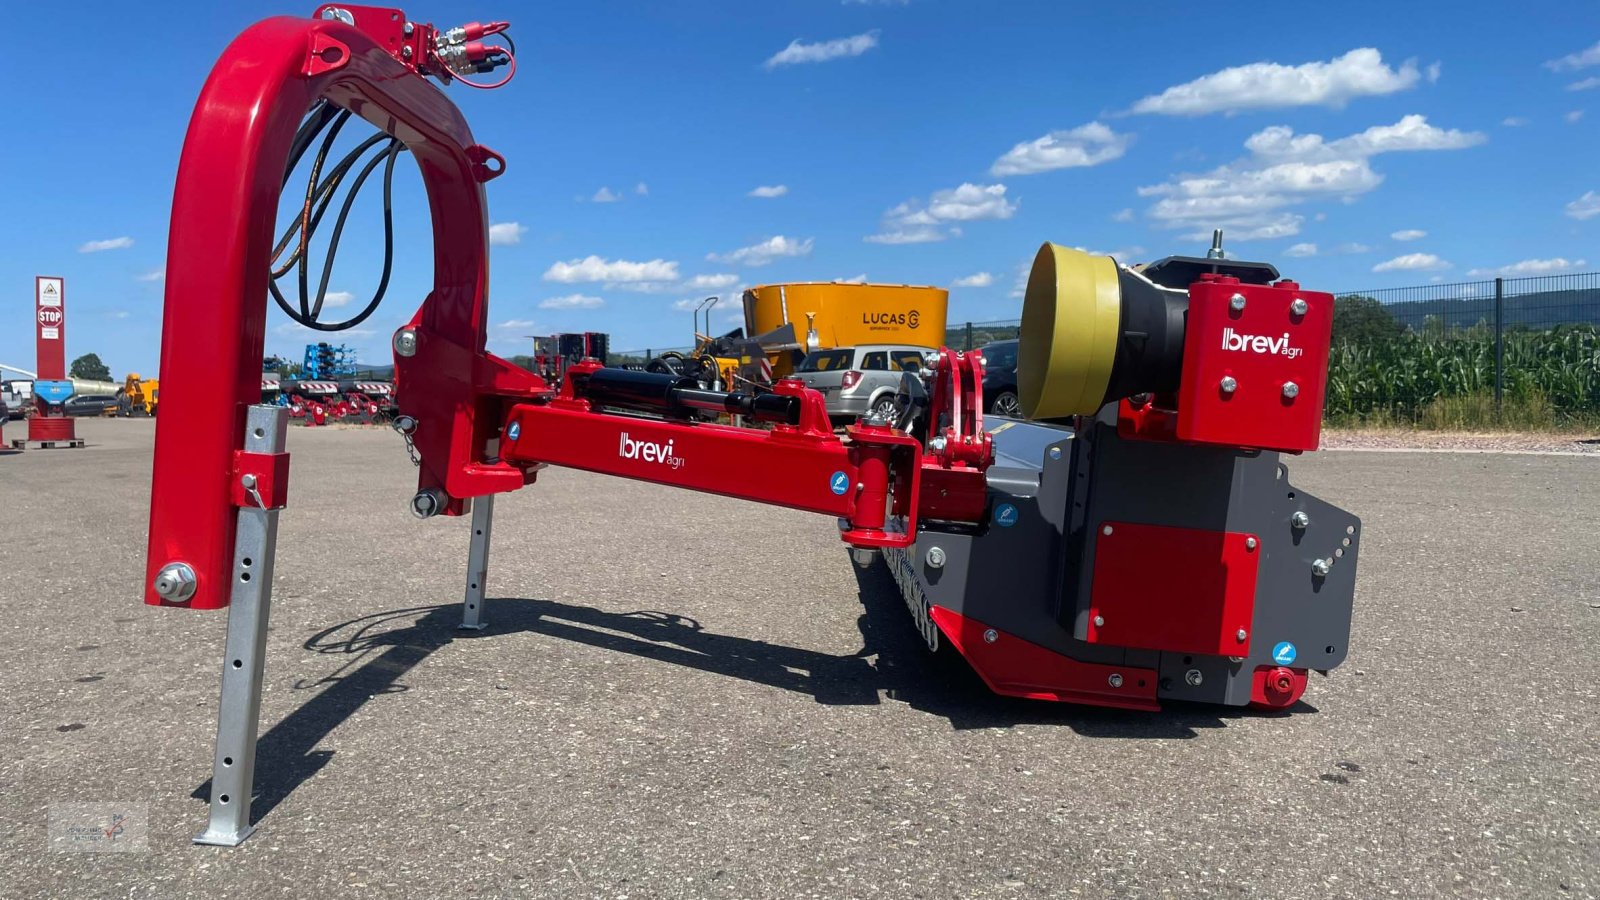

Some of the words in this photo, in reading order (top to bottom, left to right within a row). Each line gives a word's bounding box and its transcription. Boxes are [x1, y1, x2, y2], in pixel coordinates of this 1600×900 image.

[40, 311, 61, 322] STOP
[863, 312, 906, 325] LUCAS
[1222, 327, 1290, 354] brevi
[1281, 347, 1303, 359] agri
[619, 431, 674, 464] brevi
[666, 456, 685, 470] agri
